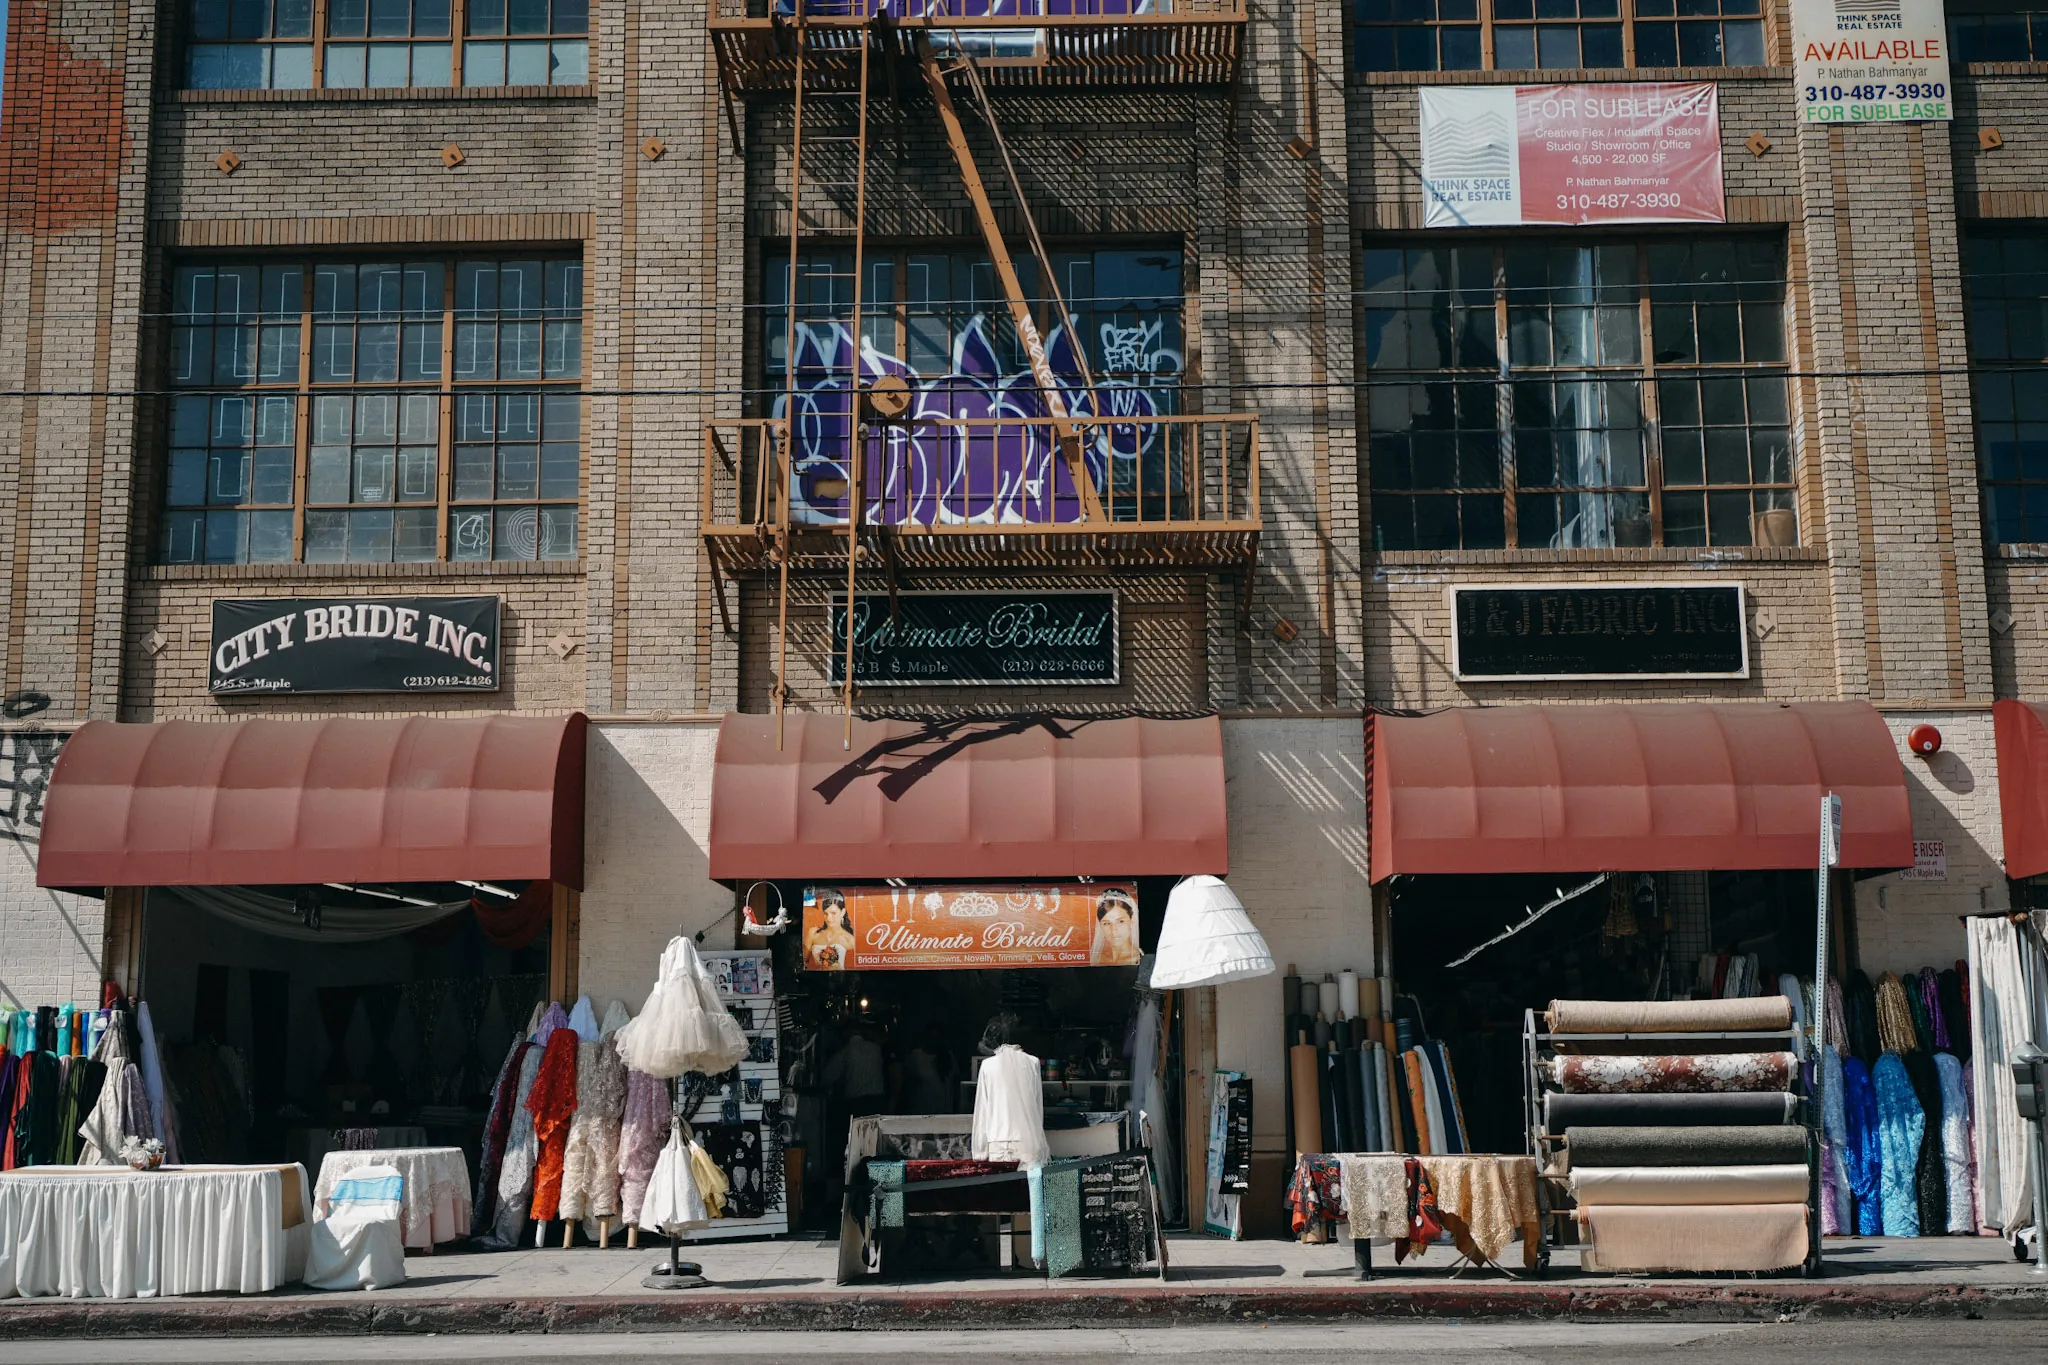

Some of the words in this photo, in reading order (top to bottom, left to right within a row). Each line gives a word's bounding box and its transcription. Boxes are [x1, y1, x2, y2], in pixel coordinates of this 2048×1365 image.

[1871, 13, 1902, 21] SPACE
[1804, 40, 1941, 62] AVAILABLE
[1818, 68, 1825, 79] P.
[1829, 67, 1865, 79] Nathan
[1869, 66, 1928, 79] Bahmanyar
[1805, 83, 1945, 102] 310-487-3930
[1528, 99, 1576, 120] FOR
[1584, 96, 1709, 118] SUBLEASE
[1807, 105, 1844, 121] FOR
[1850, 103, 1947, 120] SUBLEASE
[1535, 127, 1579, 138] Creative
[1582, 126, 1604, 137] Flex
[1614, 125, 1663, 136] Industrial
[1666, 126, 1701, 138] Space
[1546, 141, 1581, 151] Studio
[1591, 140, 1650, 151] Showroom
[1660, 139, 1691, 149] Office
[1572, 153, 1602, 165] 4,500
[1612, 153, 1649, 165] 22,000
[1651, 153, 1667, 163] SF
[1430, 180, 1469, 191] THINK
[1473, 179, 1511, 190] SPACE
[1566, 177, 1573, 186] P.
[1576, 177, 1611, 186] Nathan
[1614, 176, 1670, 187] Bahmanyar
[1431, 191, 1463, 202] REAL
[1467, 190, 1512, 201] ESTATE
[1556, 193, 1681, 210] 310-487-3930
[1538, 595, 1656, 635] FABRIC
[985, 602, 1109, 648] Bridal
[215, 613, 297, 674] CITY
[304, 604, 420, 643] BRIDE
[425, 614, 493, 673] INC.
[870, 662, 880, 674] B
[908, 661, 949, 675] Maple
[1002, 660, 1034, 673] (213)
[238, 679, 250, 688] S.
[254, 678, 291, 691] Maple
[1920, 843, 1944, 856] RISER
[1918, 869, 1933, 879] Maple
[866, 923, 974, 953] Ultimate
[981, 922, 1074, 949] Bridal
[858, 956, 880, 964] Bridal
[964, 954, 996, 963] Novelty,
[1058, 952, 1086, 961] Gloves
